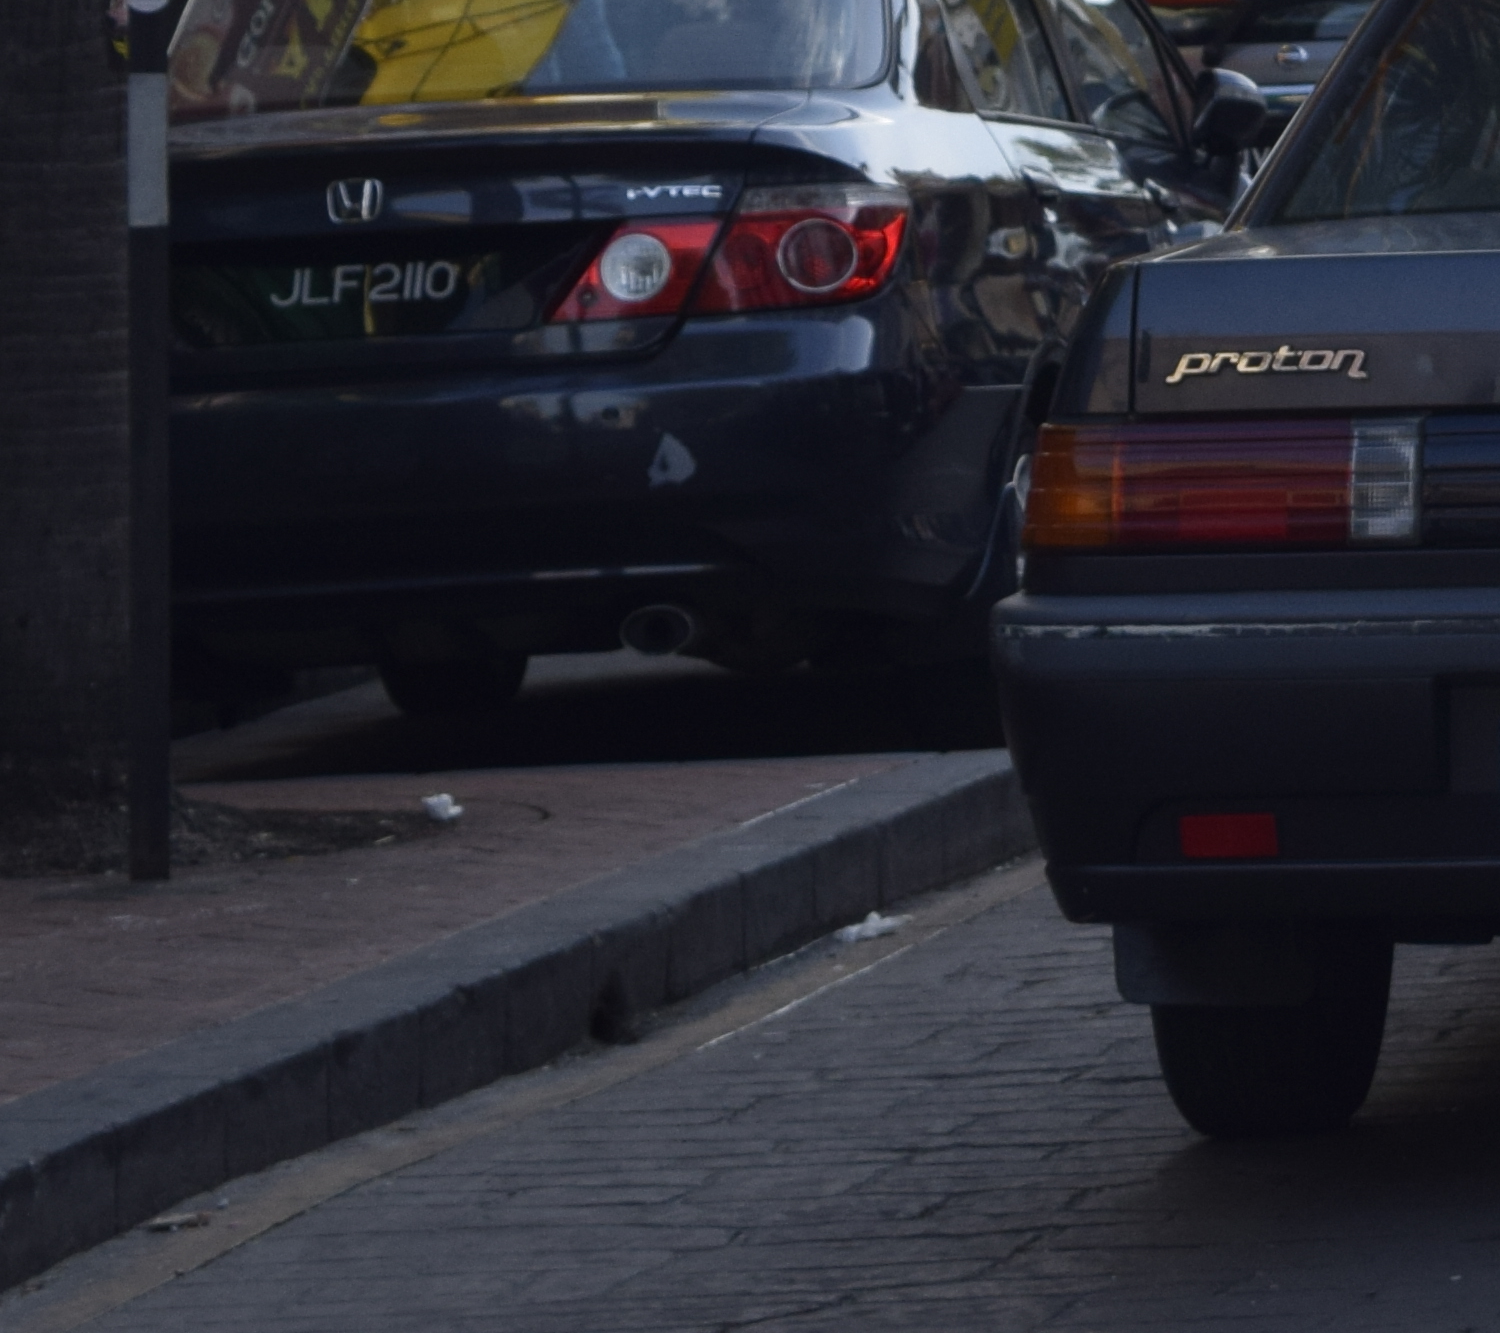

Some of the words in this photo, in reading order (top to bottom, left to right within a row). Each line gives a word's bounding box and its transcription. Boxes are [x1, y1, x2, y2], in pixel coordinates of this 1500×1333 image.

[625, 183, 724, 201] i-VTEC
[269, 264, 363, 309] JLF
[369, 261, 457, 302] 2110
[1166, 344, 1369, 383] proton
